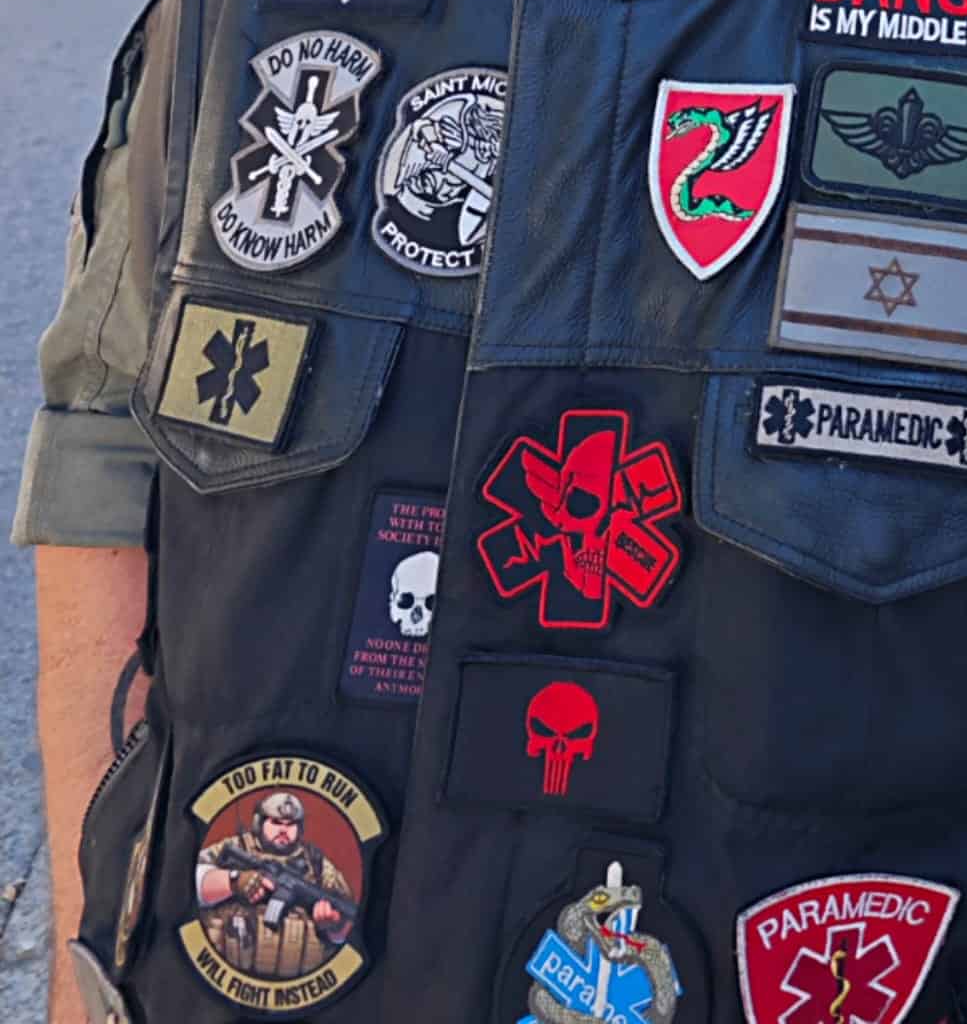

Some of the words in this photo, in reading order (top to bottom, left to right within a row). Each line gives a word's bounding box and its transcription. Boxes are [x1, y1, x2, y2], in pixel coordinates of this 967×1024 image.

[810, 4, 832, 32] IS
[836, 6, 877, 37] MY
[878, 10, 967, 46] MIDDLE
[267, 48, 294, 76] DO
[298, 38, 324, 62] NO
[324, 38, 373, 82] HARM
[410, 75, 469, 112] SAINT
[471, 75, 508, 97] MIC
[217, 201, 238, 233] DO
[228, 221, 282, 261] KNOW
[283, 210, 332, 259] HARM
[380, 220, 475, 268] PROTECT
[816, 403, 944, 450] PARAMEDIC
[377, 529, 430, 545] SOCIETY
[389, 516, 424, 530] WITH
[221, 768, 257, 795] TOO
[261, 760, 293, 781] FAT
[298, 760, 317, 780] TO
[321, 775, 358, 808] RUN
[757, 891, 931, 950] PARAMEDIC
[196, 948, 225, 986] WILL
[227, 977, 271, 1007] FIGHT
[273, 969, 338, 1007] INSTEAD
